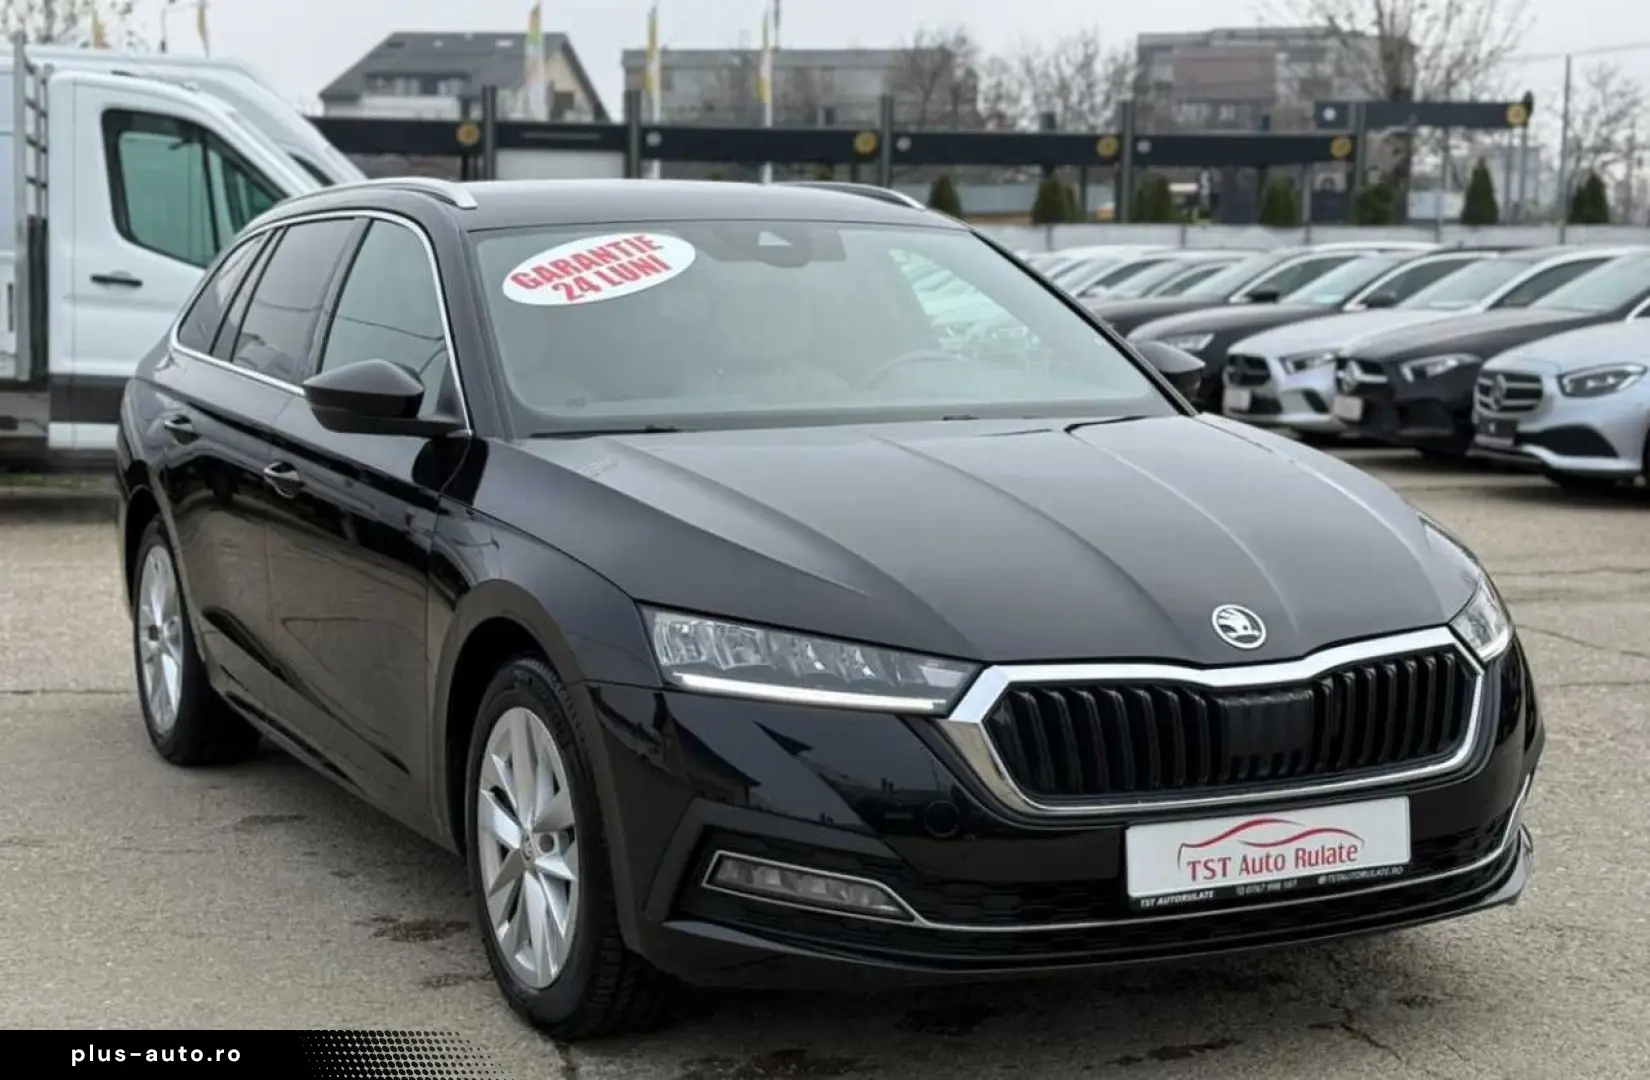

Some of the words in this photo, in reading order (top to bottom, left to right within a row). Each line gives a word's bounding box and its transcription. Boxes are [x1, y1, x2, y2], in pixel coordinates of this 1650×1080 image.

[510, 235, 664, 290] GARANTIE
[551, 276, 602, 301] 24
[593, 254, 673, 287] LUNI
[1187, 856, 1232, 881] TST
[1238, 852, 1286, 877] Auto
[1294, 842, 1358, 869] Rulate
[1140, 897, 1156, 908] TST
